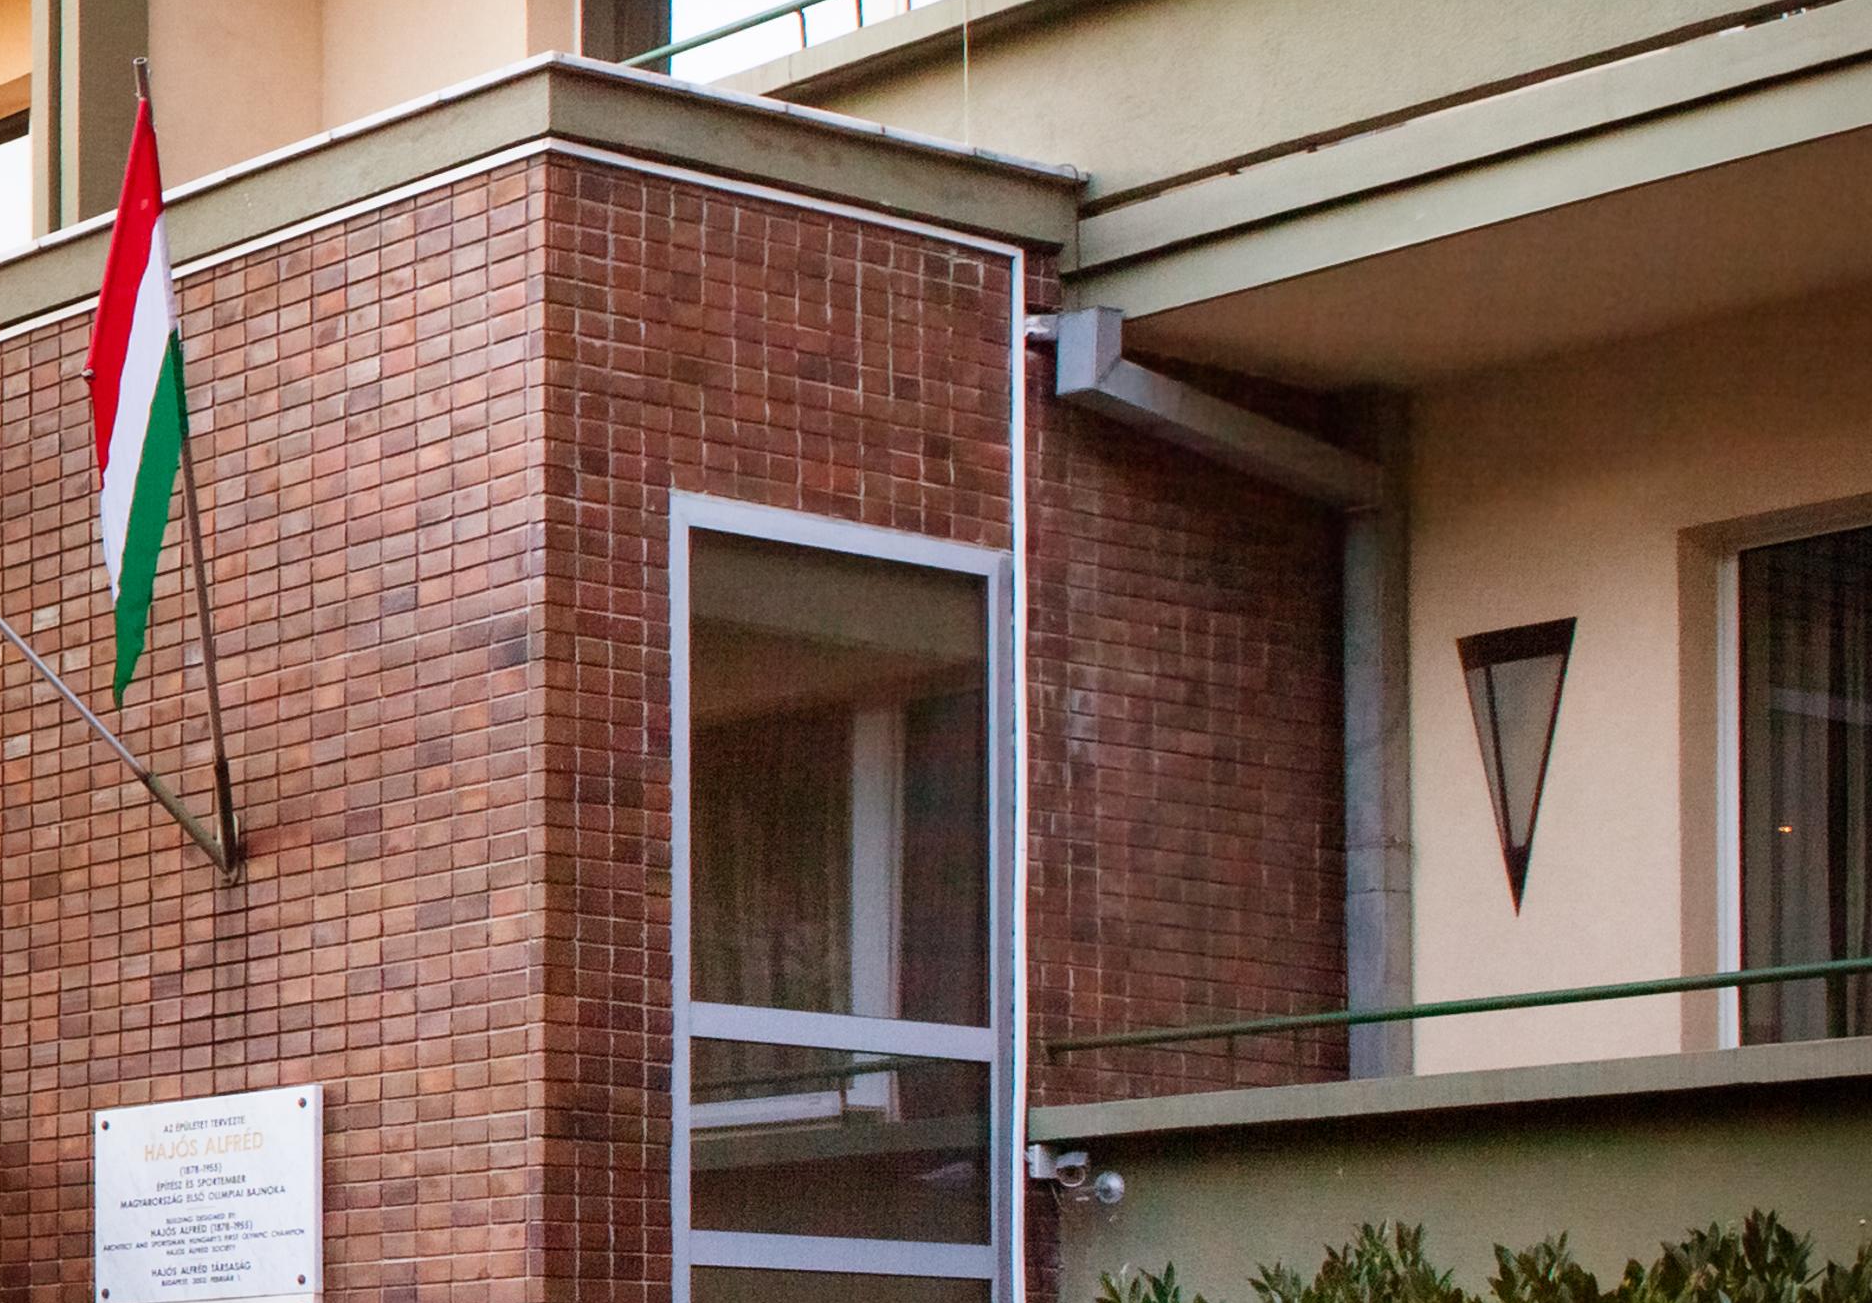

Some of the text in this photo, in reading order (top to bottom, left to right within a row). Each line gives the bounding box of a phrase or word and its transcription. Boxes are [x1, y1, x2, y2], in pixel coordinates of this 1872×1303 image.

[164, 1115, 245, 1133] AZ ÉPÜLETET TERVEZTE
[145, 1127, 264, 1162] HAJÓS ALFRÉD
[186, 1178, 194, 1189] ÉS
[197, 1175, 246, 1188] SPORTEMBER
[120, 1193, 183, 1209] MAGYARORSZÁG
[208, 1187, 243, 1200] OLIMPIAI
[247, 1185, 286, 1196] BAJNOKA
[150, 1225, 176, 1237] HAJÓS
[180, 1222, 206, 1235] ALFRÉD
[136, 1241, 148, 1249] AND
[151, 1260, 251, 1277] HAJÓS ALFRÉD TÁRSASÁG
